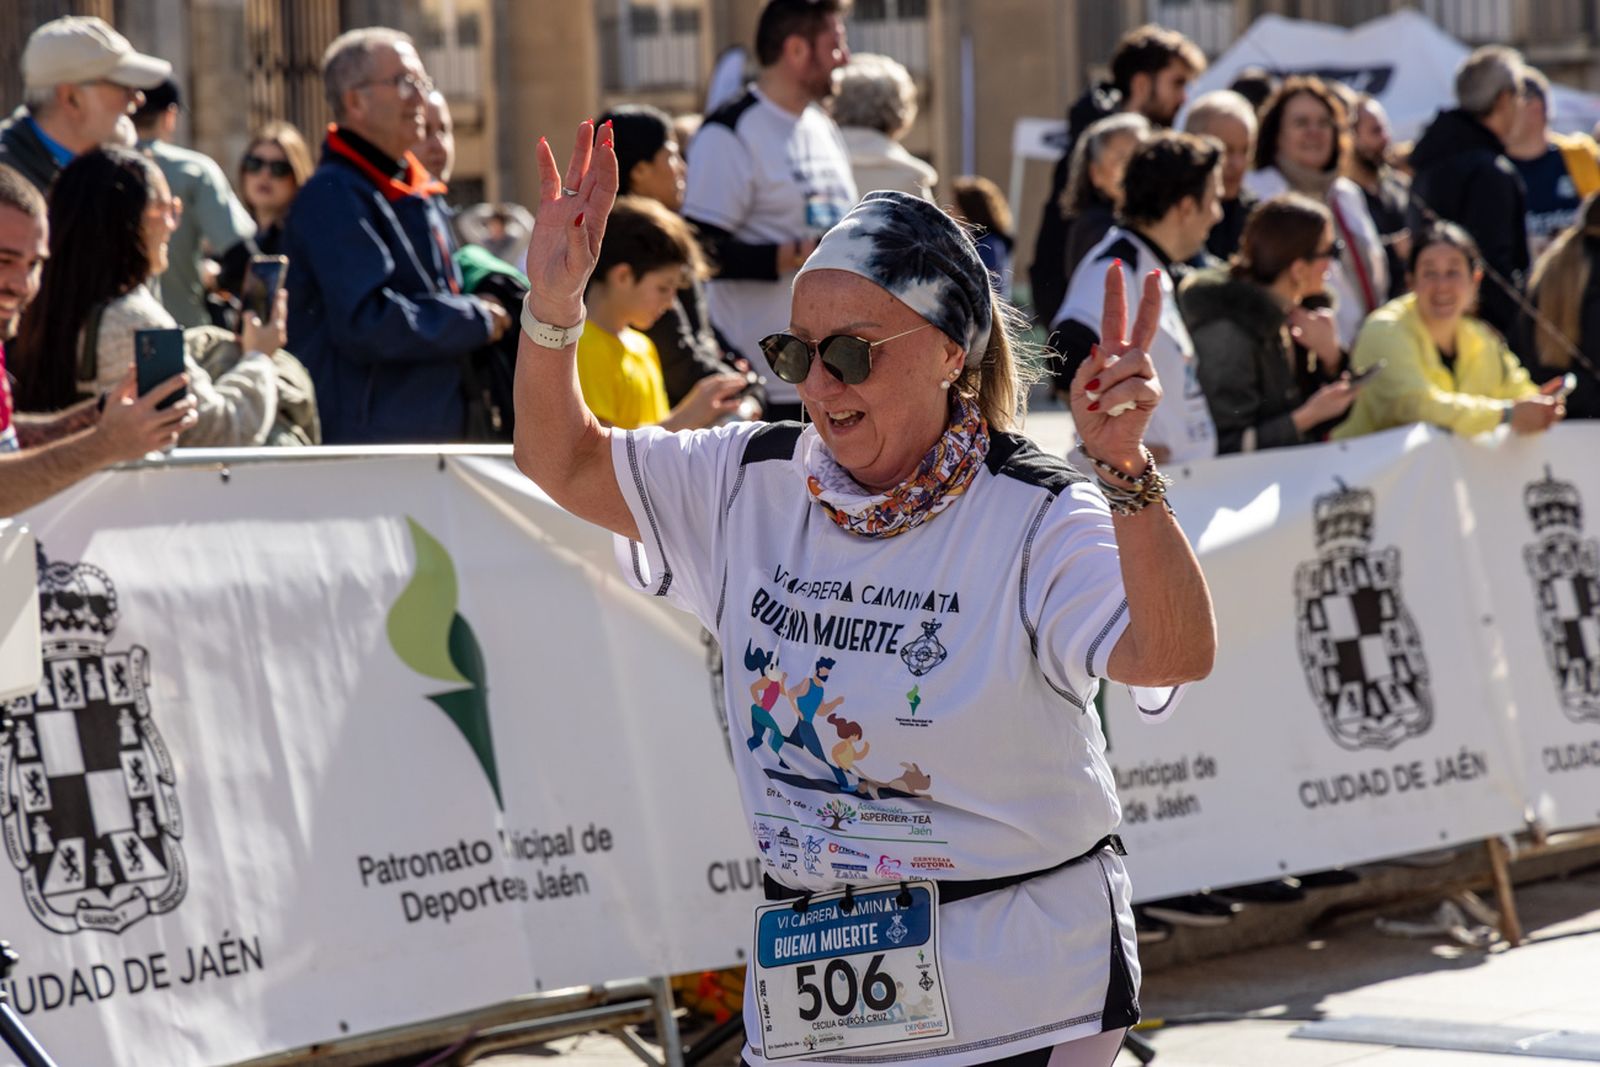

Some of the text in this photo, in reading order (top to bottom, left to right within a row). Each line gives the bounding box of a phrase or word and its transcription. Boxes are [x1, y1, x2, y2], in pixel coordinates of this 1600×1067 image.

[787, 578, 853, 603] ARRERA
[862, 585, 960, 613] CAMINATA
[751, 587, 904, 654] BUENA MUERTE
[1193, 751, 1217, 780] de
[1299, 743, 1488, 809] CIUDAD DE JAÉN
[908, 825, 932, 836] Jaén
[357, 838, 493, 888] Patronato
[581, 822, 614, 853] de
[534, 865, 590, 902] Jaén
[777, 897, 909, 929] VI CARRERA CAMINAT
[774, 922, 878, 960] BUENA MUERTE
[1, 930, 264, 1016] UDAD DE JAÉN
[796, 954, 897, 1022] 506
[811, 1019, 837, 1031] CECILIA
[866, 1012, 888, 1024] CRUZ
